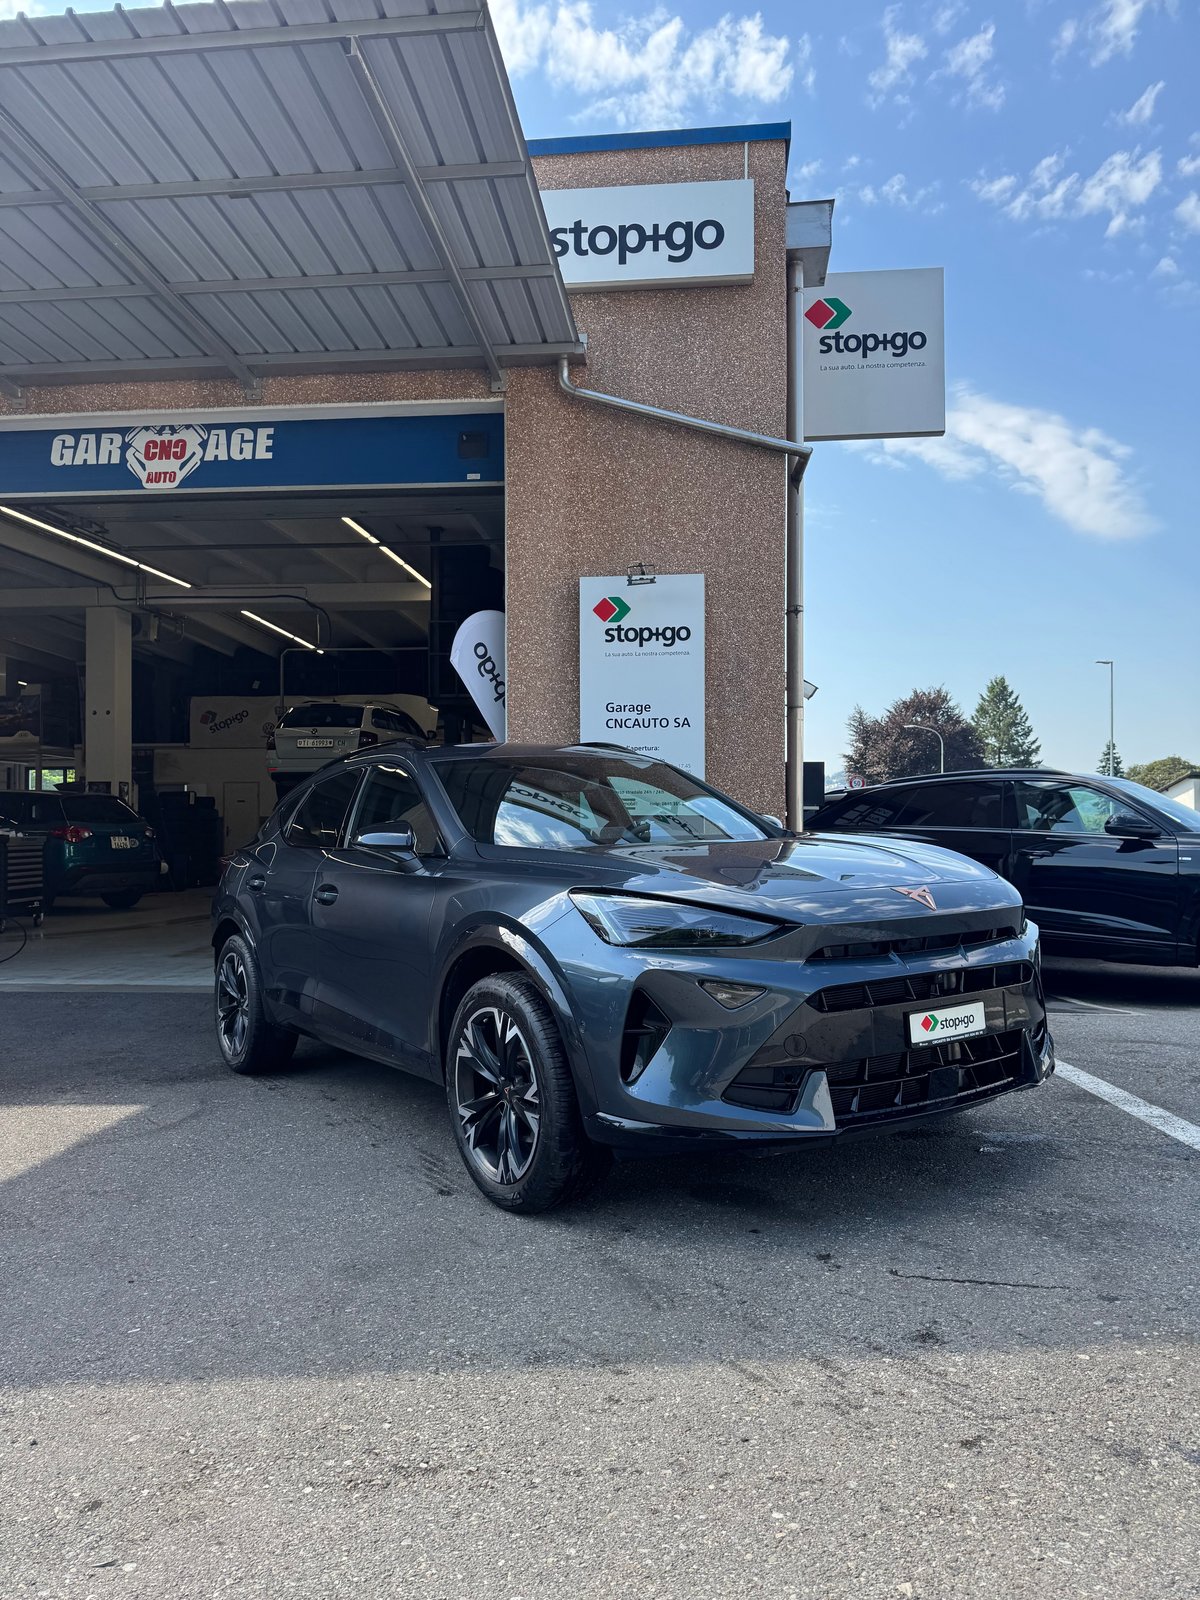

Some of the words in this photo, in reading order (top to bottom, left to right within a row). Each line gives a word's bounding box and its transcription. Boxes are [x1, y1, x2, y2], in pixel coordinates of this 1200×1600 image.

[550, 219, 725, 265] stop+go
[819, 331, 927, 358] stop+go
[886, 361, 927, 369] competenza.
[50, 432, 123, 467] GAR
[203, 427, 275, 462] AGE
[145, 471, 177, 484] AUTO
[604, 624, 691, 648] stop+go
[605, 702, 652, 715] Garage
[605, 717, 670, 729] CNCAUTO
[673, 717, 691, 728] SA
[940, 1014, 975, 1030] stop+go
